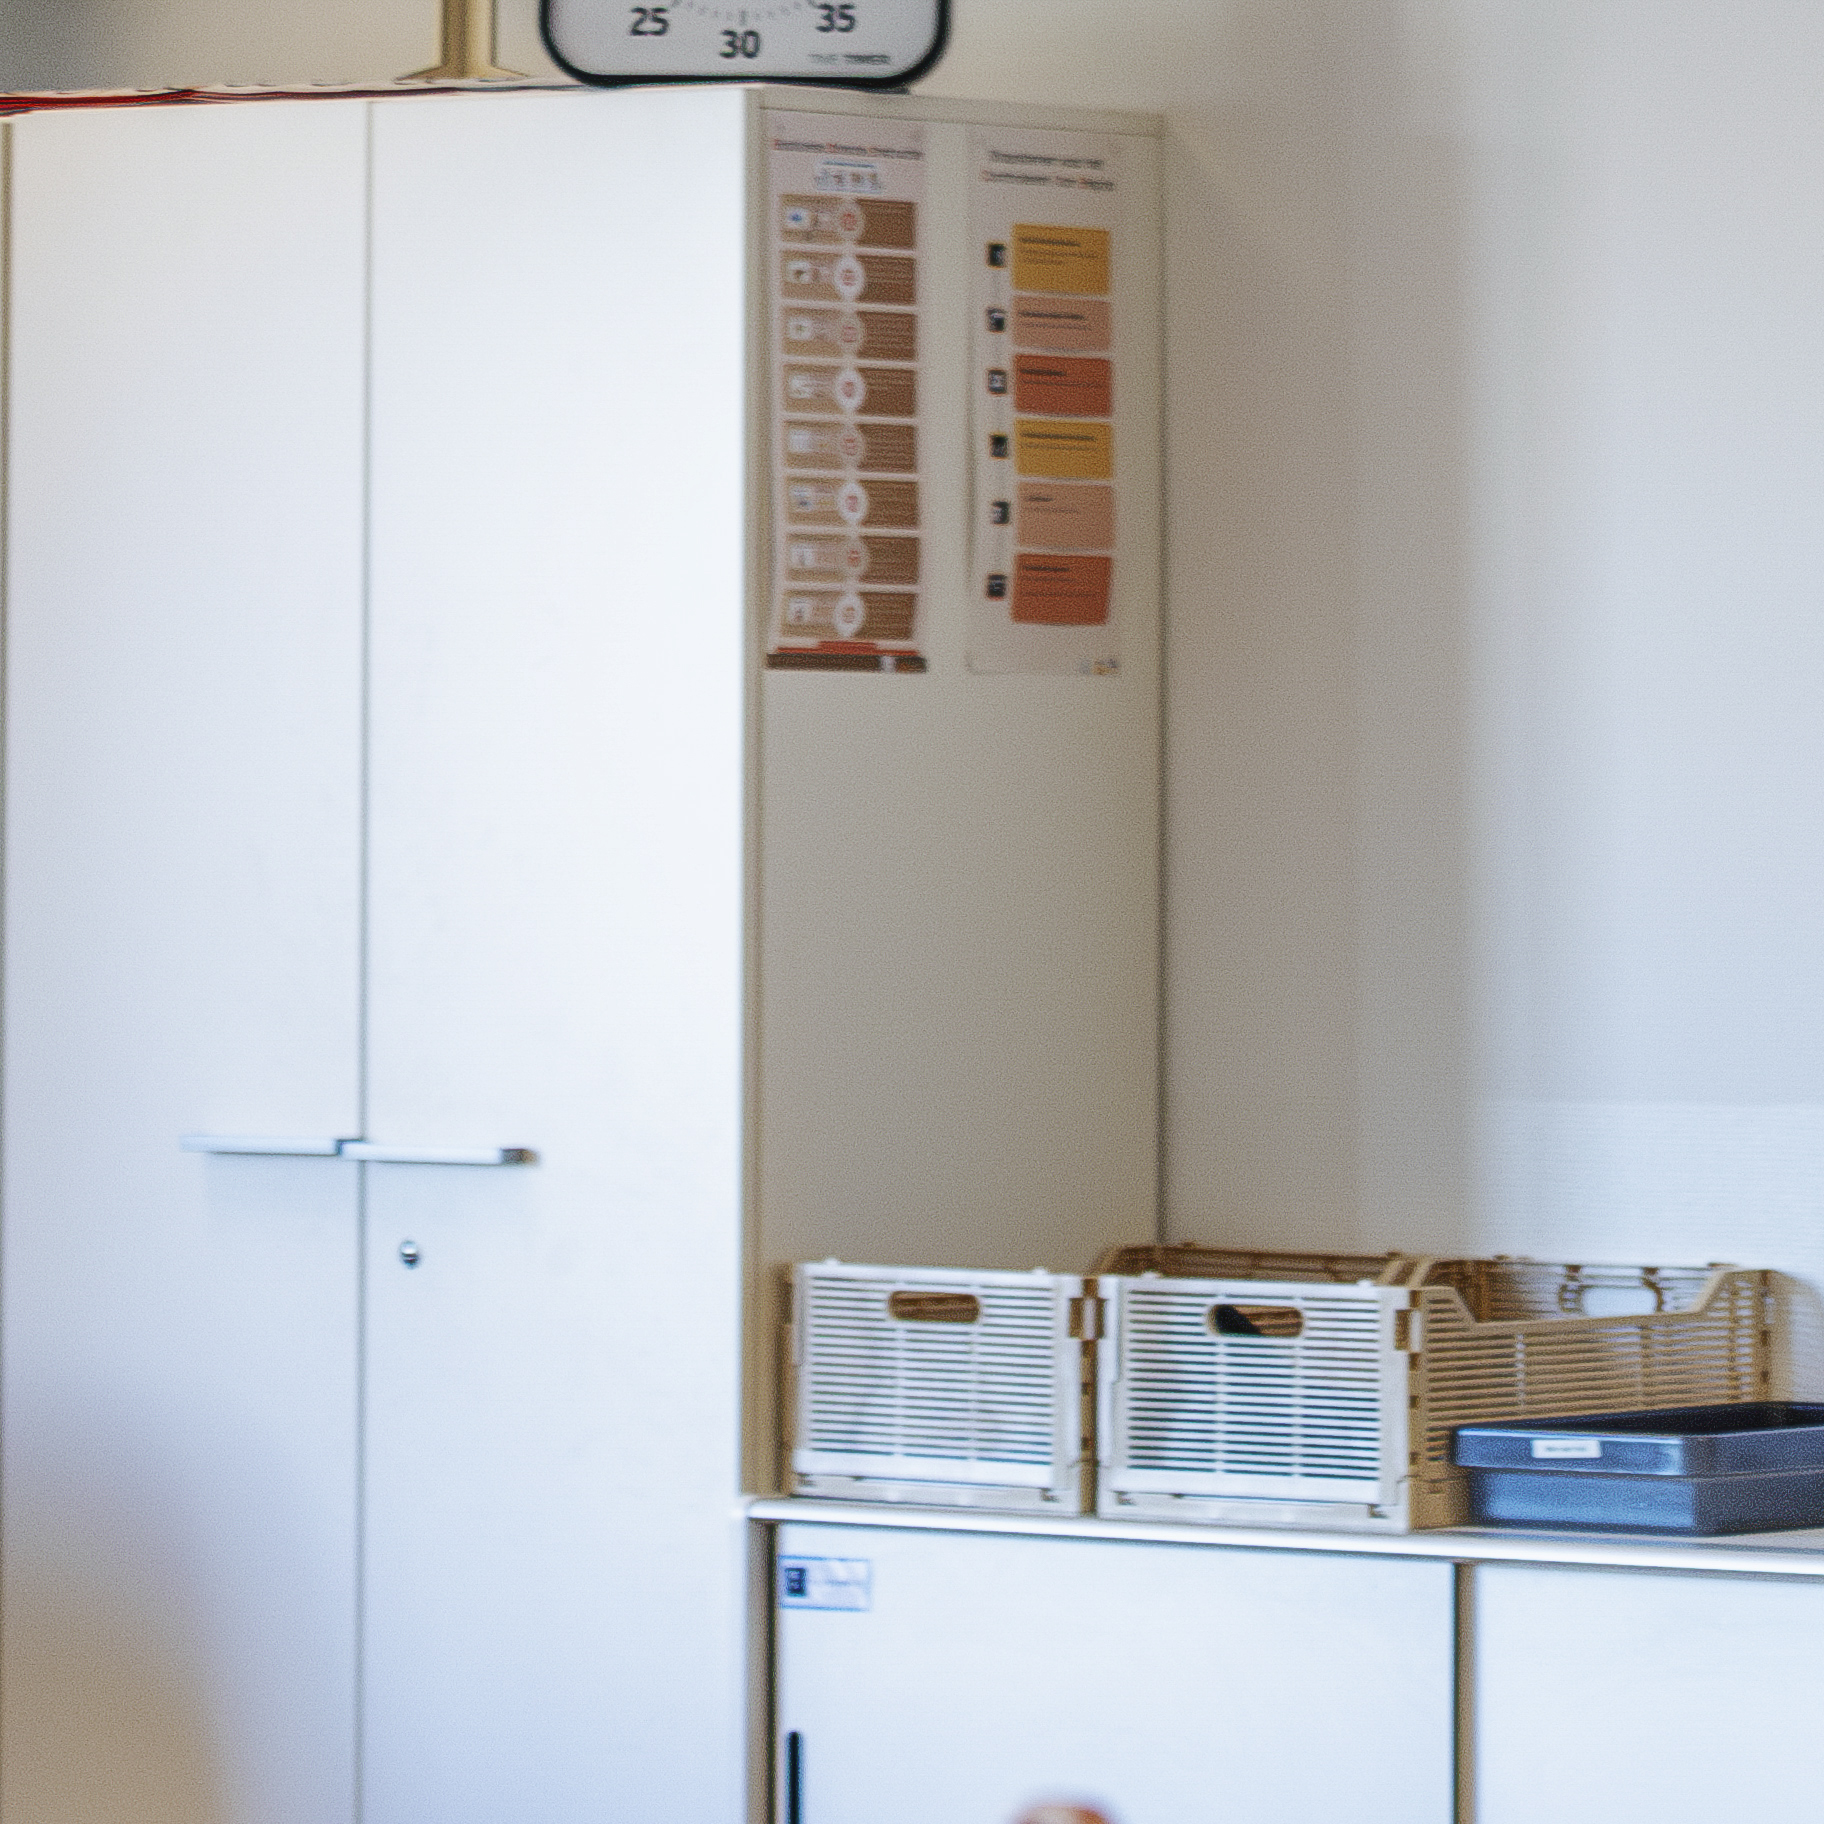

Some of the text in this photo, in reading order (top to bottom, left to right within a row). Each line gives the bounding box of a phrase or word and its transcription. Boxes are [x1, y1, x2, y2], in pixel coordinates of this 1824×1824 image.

[629, 6, 670, 37] 25
[815, 3, 857, 33] 35
[719, 29, 762, 60] 30
